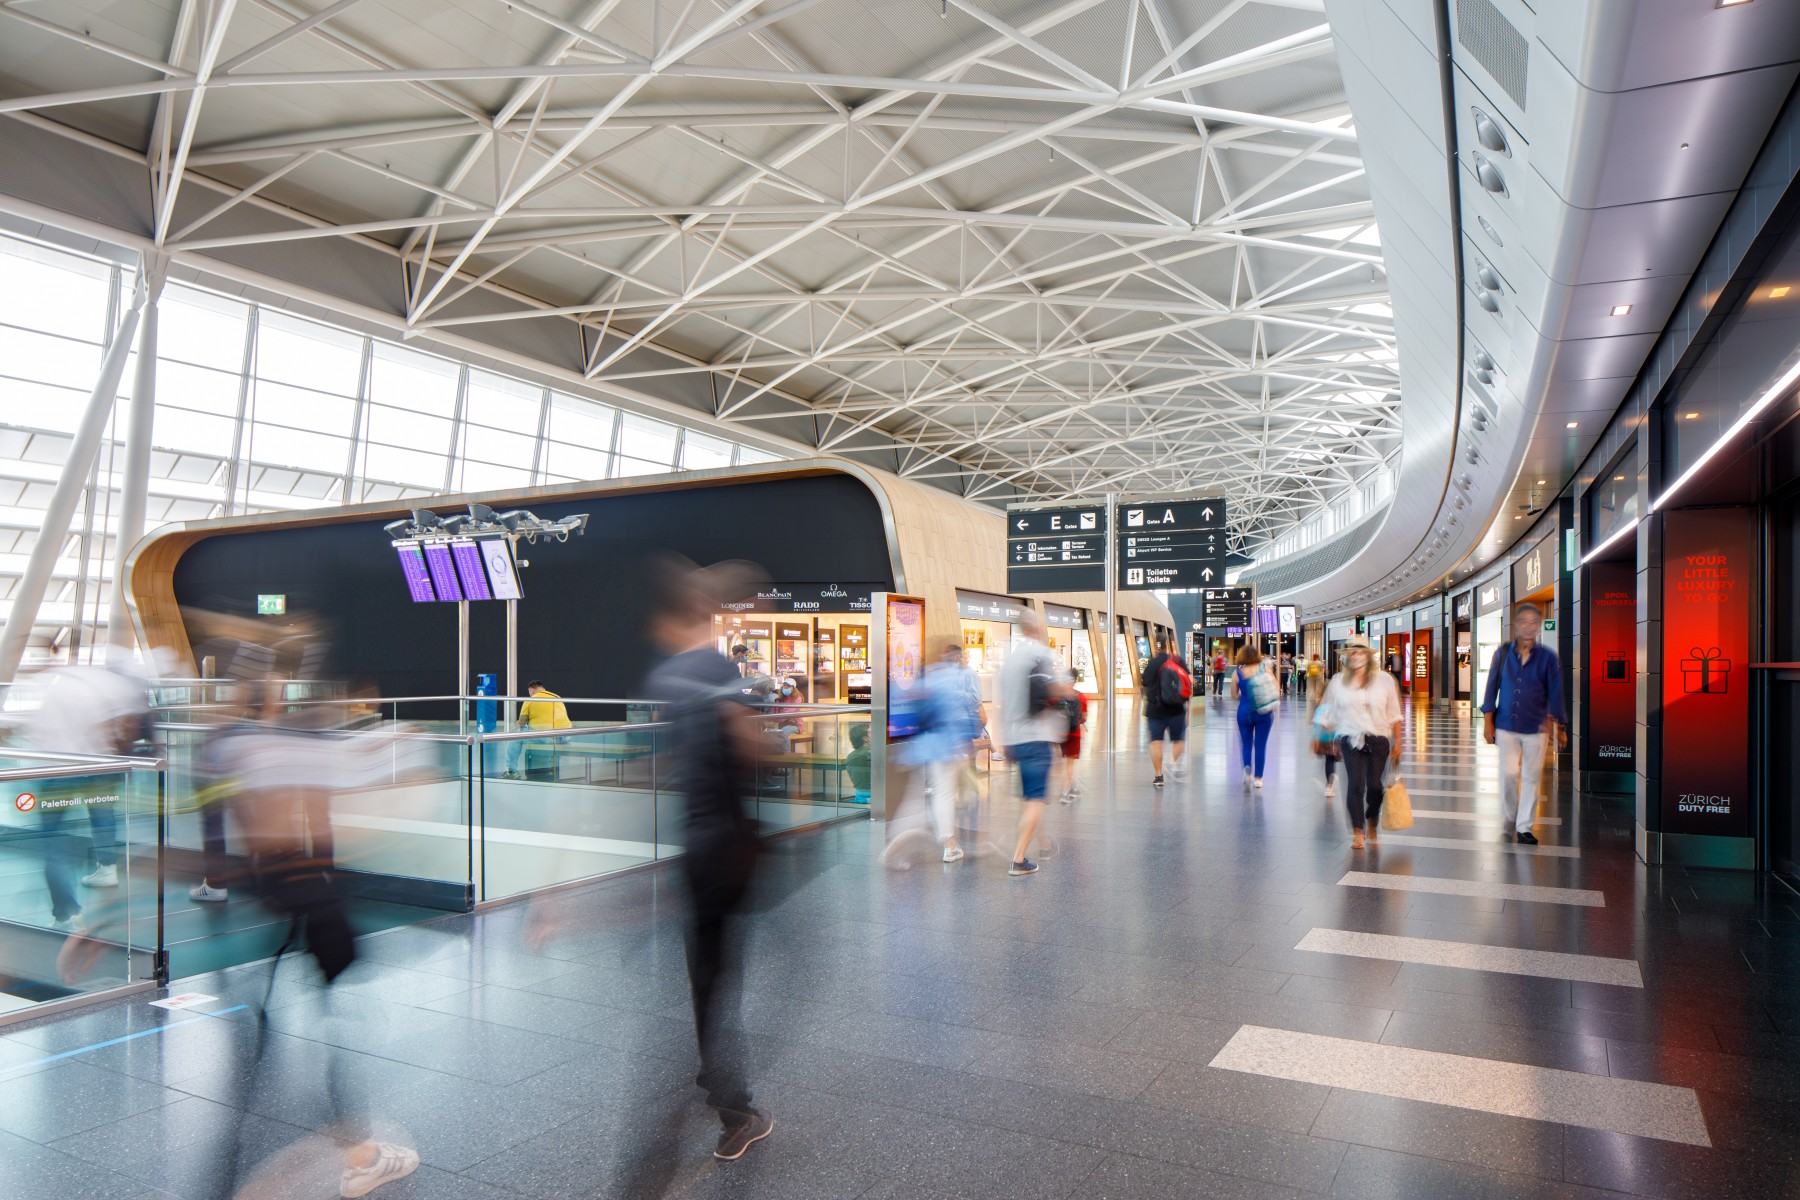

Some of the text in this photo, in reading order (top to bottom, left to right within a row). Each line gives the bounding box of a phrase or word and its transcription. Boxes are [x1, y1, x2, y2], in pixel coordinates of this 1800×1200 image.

[1162, 509, 1175, 524] A
[1051, 516, 1061, 530] E
[1686, 555, 1727, 566] YOUR
[1684, 568, 1728, 579] LITTLE
[1678, 580, 1735, 591] LUXURY
[1683, 593, 1729, 603] TO GO
[1599, 745, 1632, 753] ZÜRICH
[41, 794, 119, 808] Palettrolli verboten
[1678, 793, 1730, 805] ZÜRICH
[1678, 805, 1730, 814] DUTY FREE
